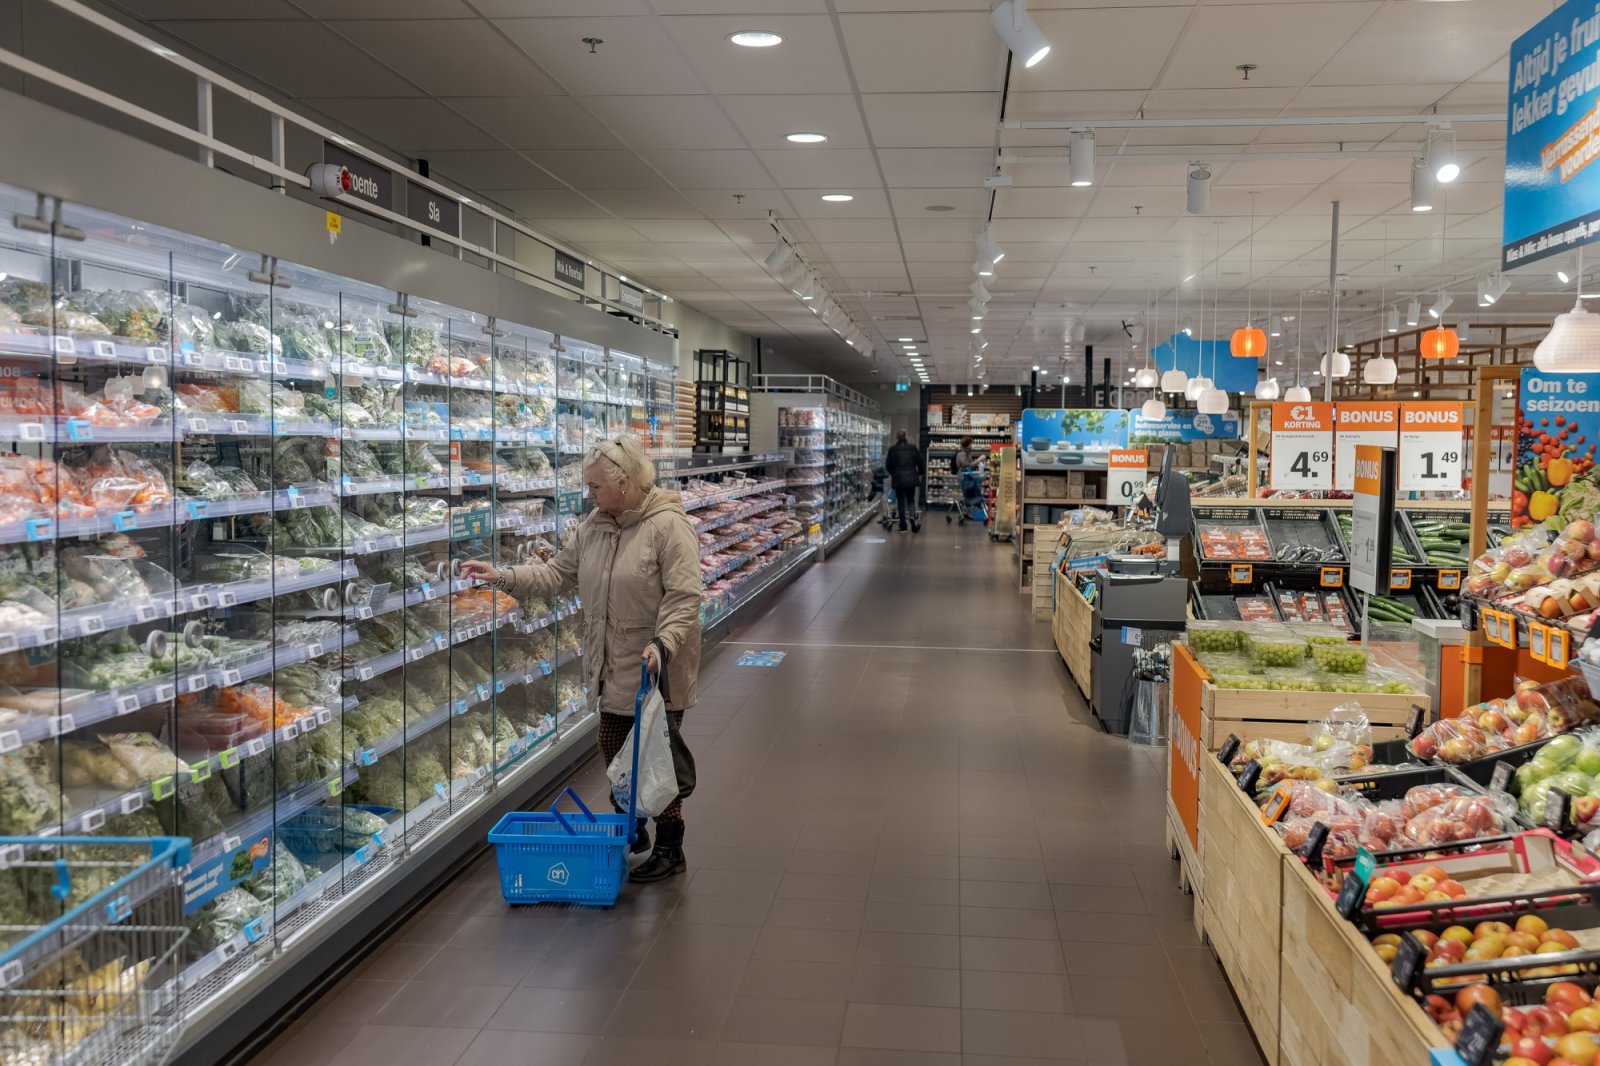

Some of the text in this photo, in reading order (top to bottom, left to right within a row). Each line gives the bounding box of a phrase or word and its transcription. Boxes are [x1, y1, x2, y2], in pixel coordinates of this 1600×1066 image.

[1513, 39, 1551, 93] Altijd
[1552, 31, 1567, 76] je
[1512, 86, 1556, 135] lekker
[350, 172, 378, 199] roente
[428, 201, 440, 222] Sla
[1528, 377, 1587, 393] Om te
[1526, 395, 1600, 412] seizoen
[1290, 405, 1315, 420] €1
[1341, 411, 1393, 423] BONUS
[1405, 411, 1459, 423] BONUS
[1284, 421, 1320, 429] KORTING
[1112, 454, 1144, 463] BONUS
[1356, 460, 1379, 479] BONUS
